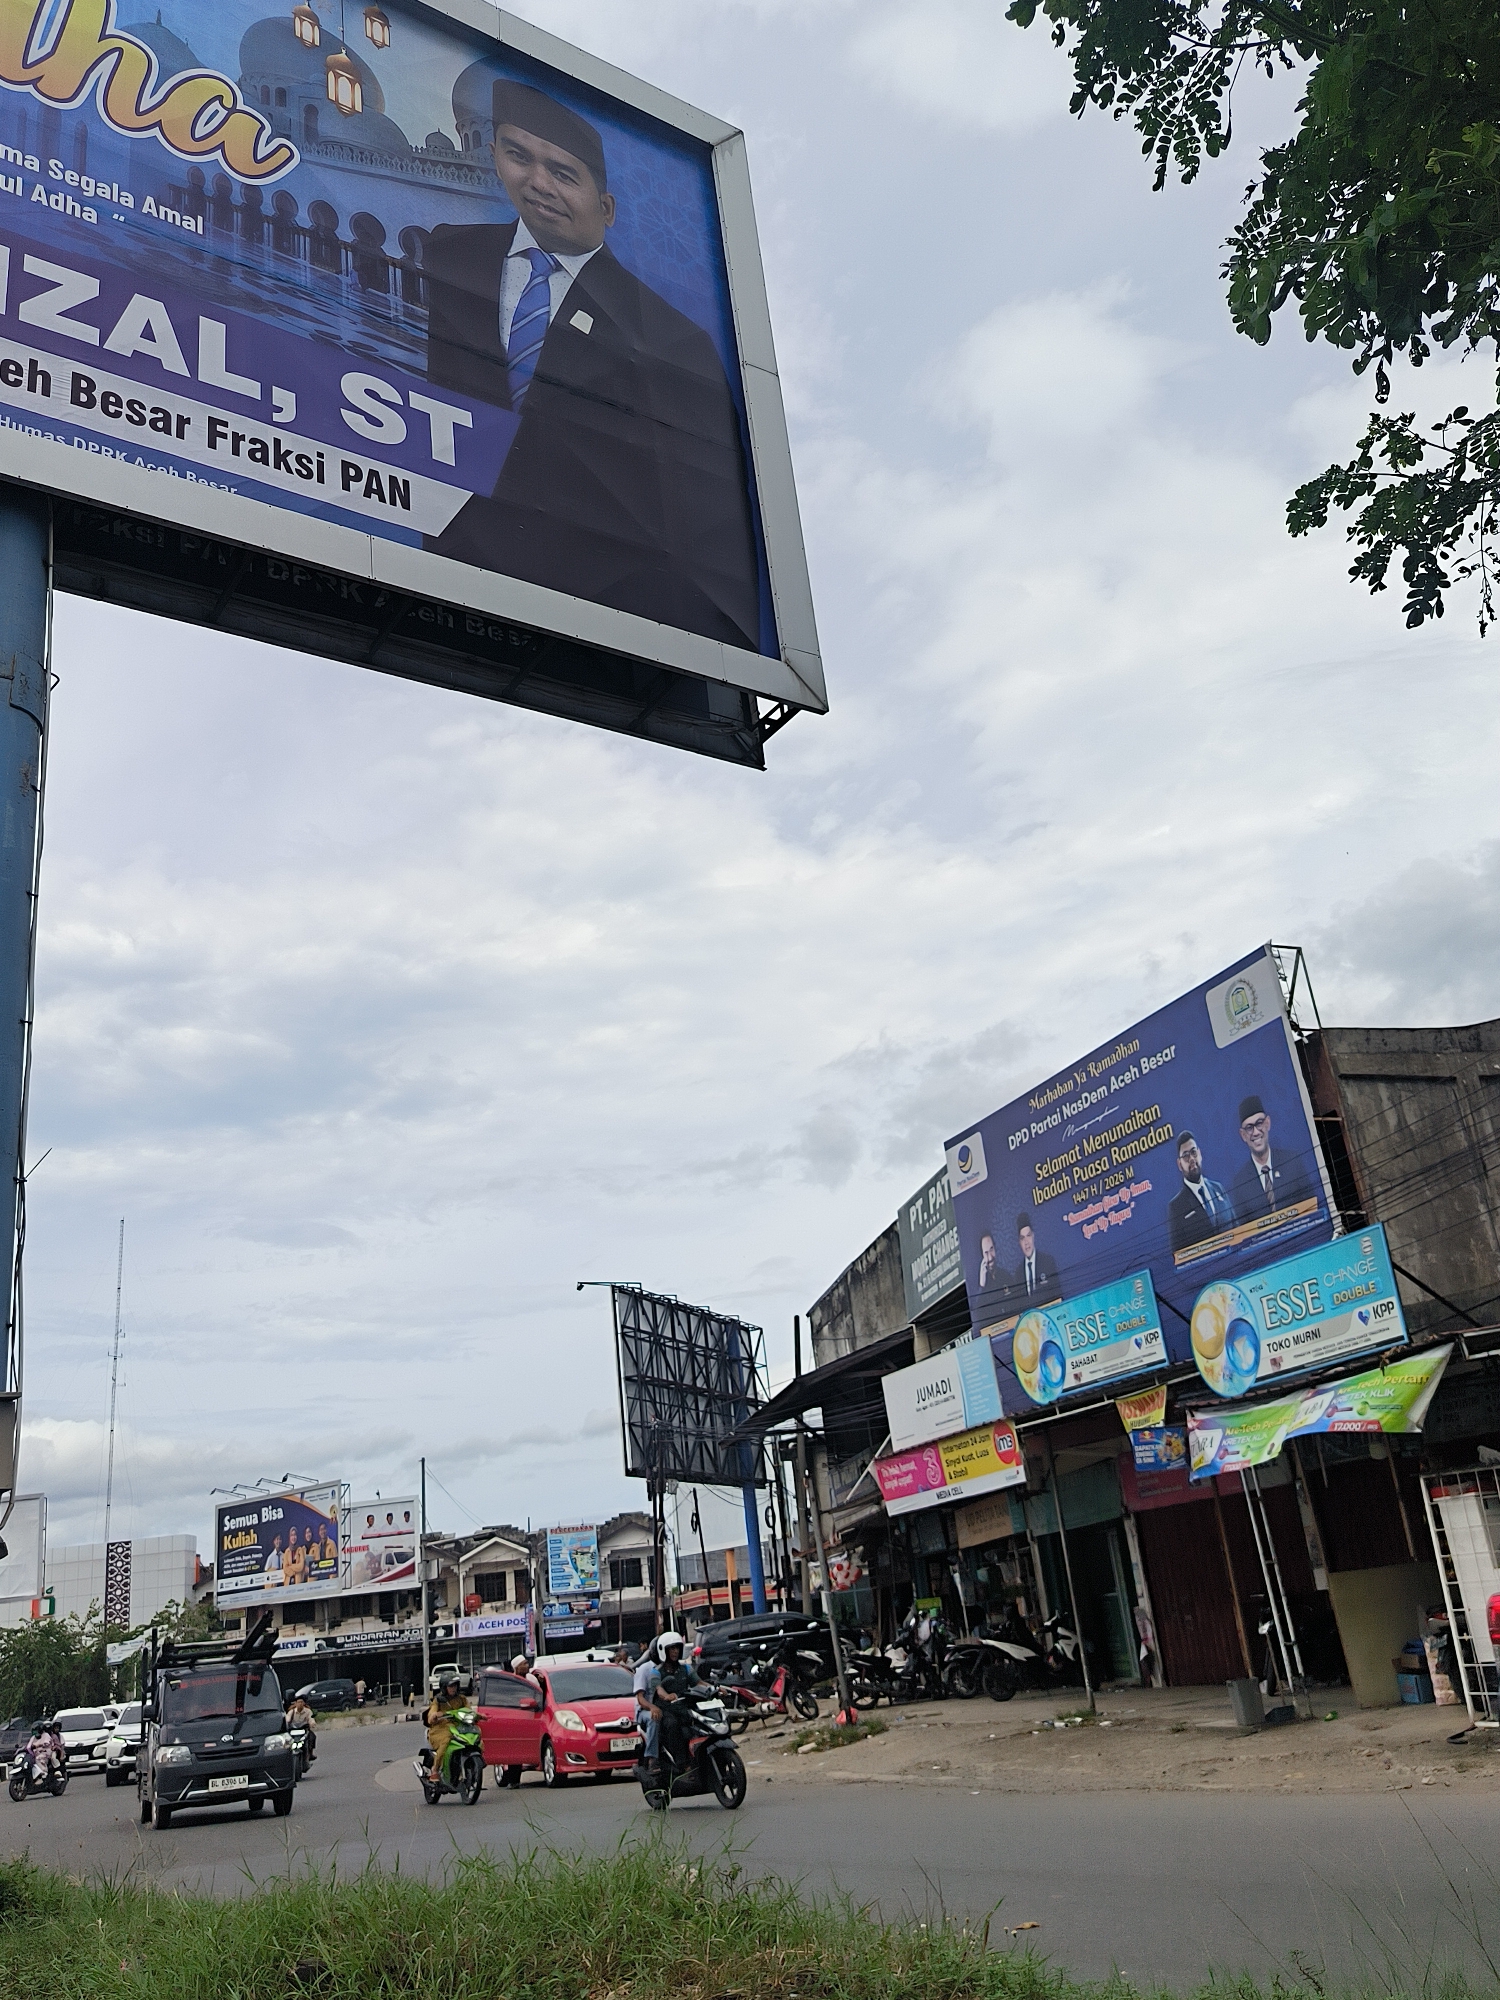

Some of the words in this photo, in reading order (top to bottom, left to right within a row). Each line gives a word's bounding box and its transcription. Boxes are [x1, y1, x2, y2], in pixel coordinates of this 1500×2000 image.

[31, 184, 98, 225] Adha
[48, 157, 136, 209] Segala
[141, 195, 204, 236] Amal
[339, 371, 475, 467] ST
[69, 369, 191, 440] Besar
[206, 414, 327, 487] Fraksi
[340, 458, 412, 512] PAN
[1028, 1078, 1073, 1115] Marhaban
[1073, 1069, 1087, 1092] Ya
[1086, 1038, 1140, 1078] Ramadhan
[1008, 1127, 1029, 1150] DPD
[1030, 1109, 1061, 1138] Partai
[1061, 1085, 1108, 1119] NasDem
[1109, 1066, 1140, 1093] Aceh
[1140, 1044, 1176, 1075] Besar
[1034, 1144, 1082, 1182] Selamat
[1082, 1103, 1161, 1157] Menunaikan
[1032, 1175, 1072, 1206] Ibadah
[1072, 1155, 1110, 1186] Puasa
[1111, 1123, 1174, 1166] Ramadan
[1072, 1187, 1089, 1205] 1447
[1090, 1183, 1098, 1195] H
[1099, 1179, 1103, 1194] /
[1104, 1172, 1124, 1191] 2026
[1125, 1166, 1134, 1179] M
[909, 1197, 928, 1232] PT.
[1323, 1257, 1377, 1288] CHANGE
[1108, 1295, 1147, 1318] CHANGE
[1260, 1278, 1324, 1331] ESSE
[1333, 1280, 1377, 1306] DOUBLE
[1372, 1300, 1395, 1320] KPP
[1064, 1310, 1110, 1351] ESSE
[1116, 1314, 1147, 1333] DOUBLE
[1144, 1330, 1160, 1346] KPP
[1266, 1337, 1291, 1353] TOKO
[1292, 1328, 1322, 1346] MURNI
[1071, 1353, 1098, 1370] SAHABAT
[917, 1377, 952, 1404] JUMADI
[1369, 1388, 1396, 1398] KLIK
[970, 1436, 978, 1446] 24
[979, 1434, 990, 1444] Jam
[1221, 1435, 1250, 1446] KRETEK
[945, 1457, 961, 1467] Sinyal
[976, 1448, 989, 1458] Luas
[953, 1466, 968, 1479] Stabil
[936, 1489, 952, 1500] MEDIA
[952, 1486, 964, 1496] CELL
[224, 1513, 259, 1531] Semua
[261, 1505, 284, 1523] Bisa
[224, 1529, 258, 1550] Kuliah
[336, 1631, 400, 1644] BUNDARAN
[478, 1620, 504, 1630] ACEH
